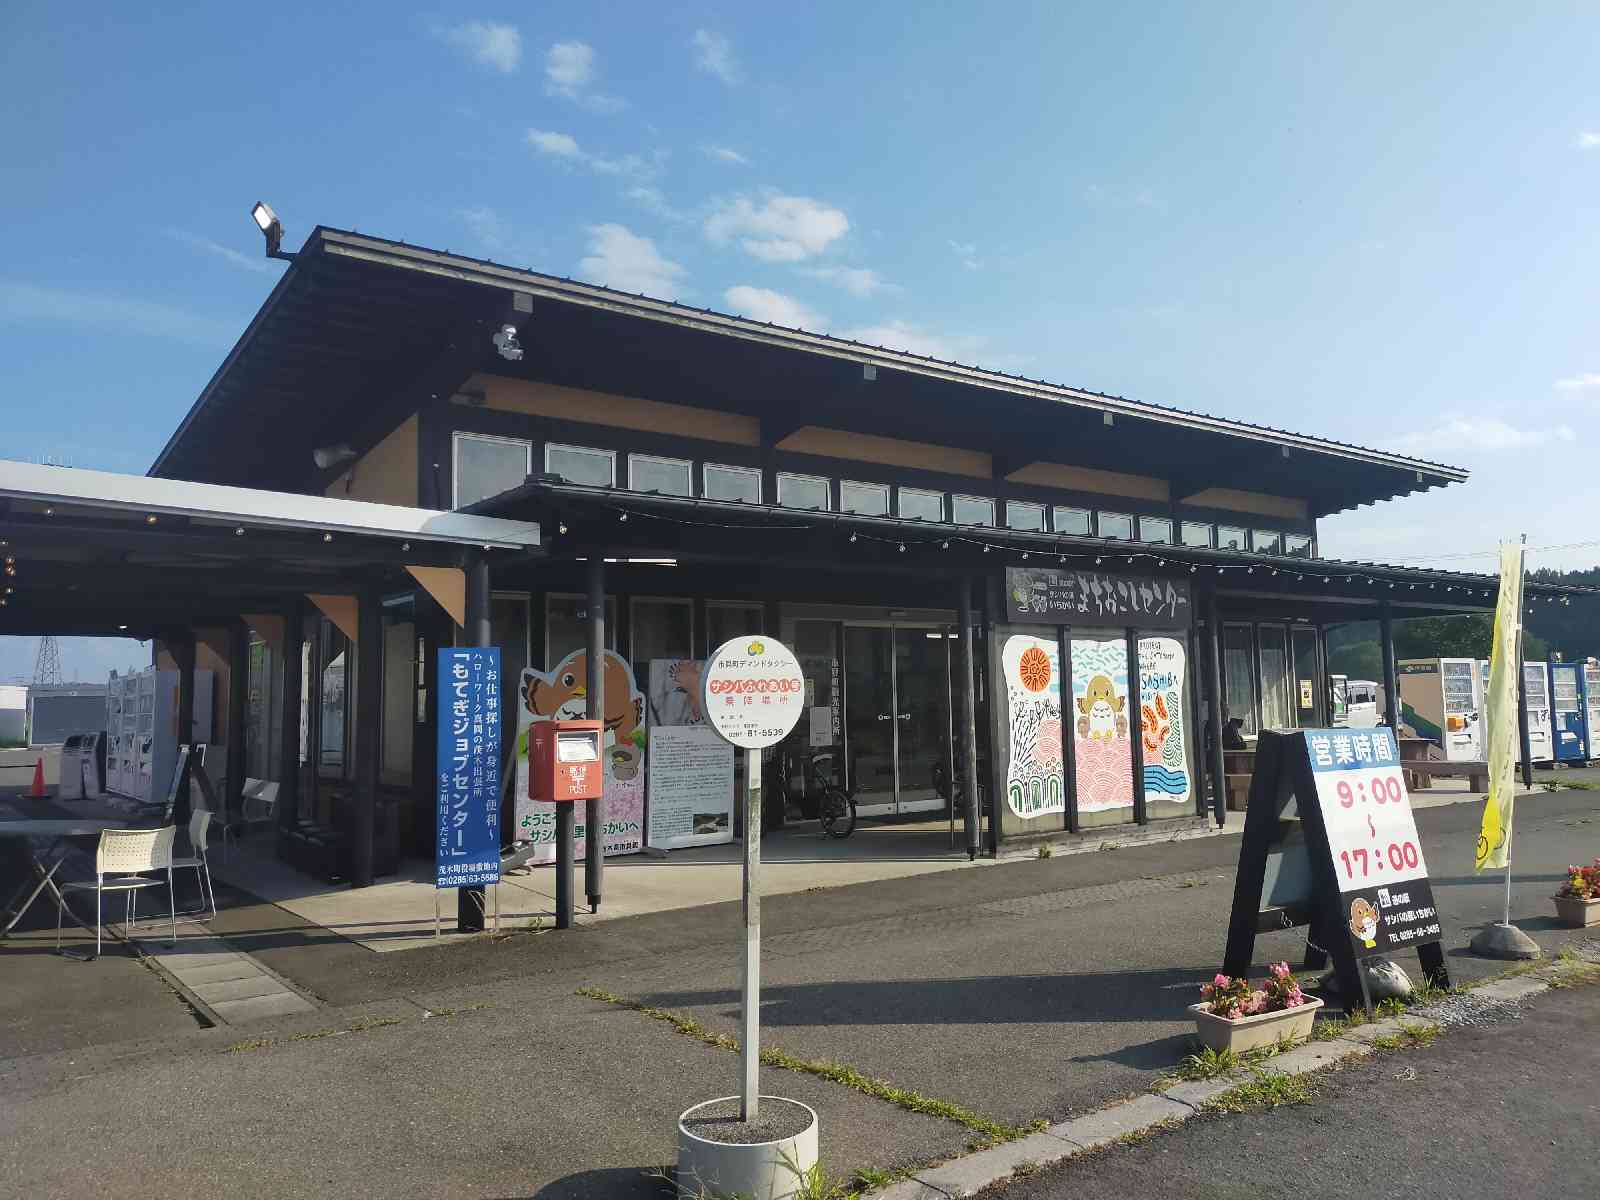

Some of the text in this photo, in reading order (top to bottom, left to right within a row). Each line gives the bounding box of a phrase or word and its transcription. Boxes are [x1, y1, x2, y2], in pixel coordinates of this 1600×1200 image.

[1311, 733, 1394, 767] 営業時間
[569, 784, 588, 794] POST
[1336, 775, 1402, 809] 9:00
[1340, 841, 1419, 880] 17:00
[1388, 933, 1401, 943] TEL
